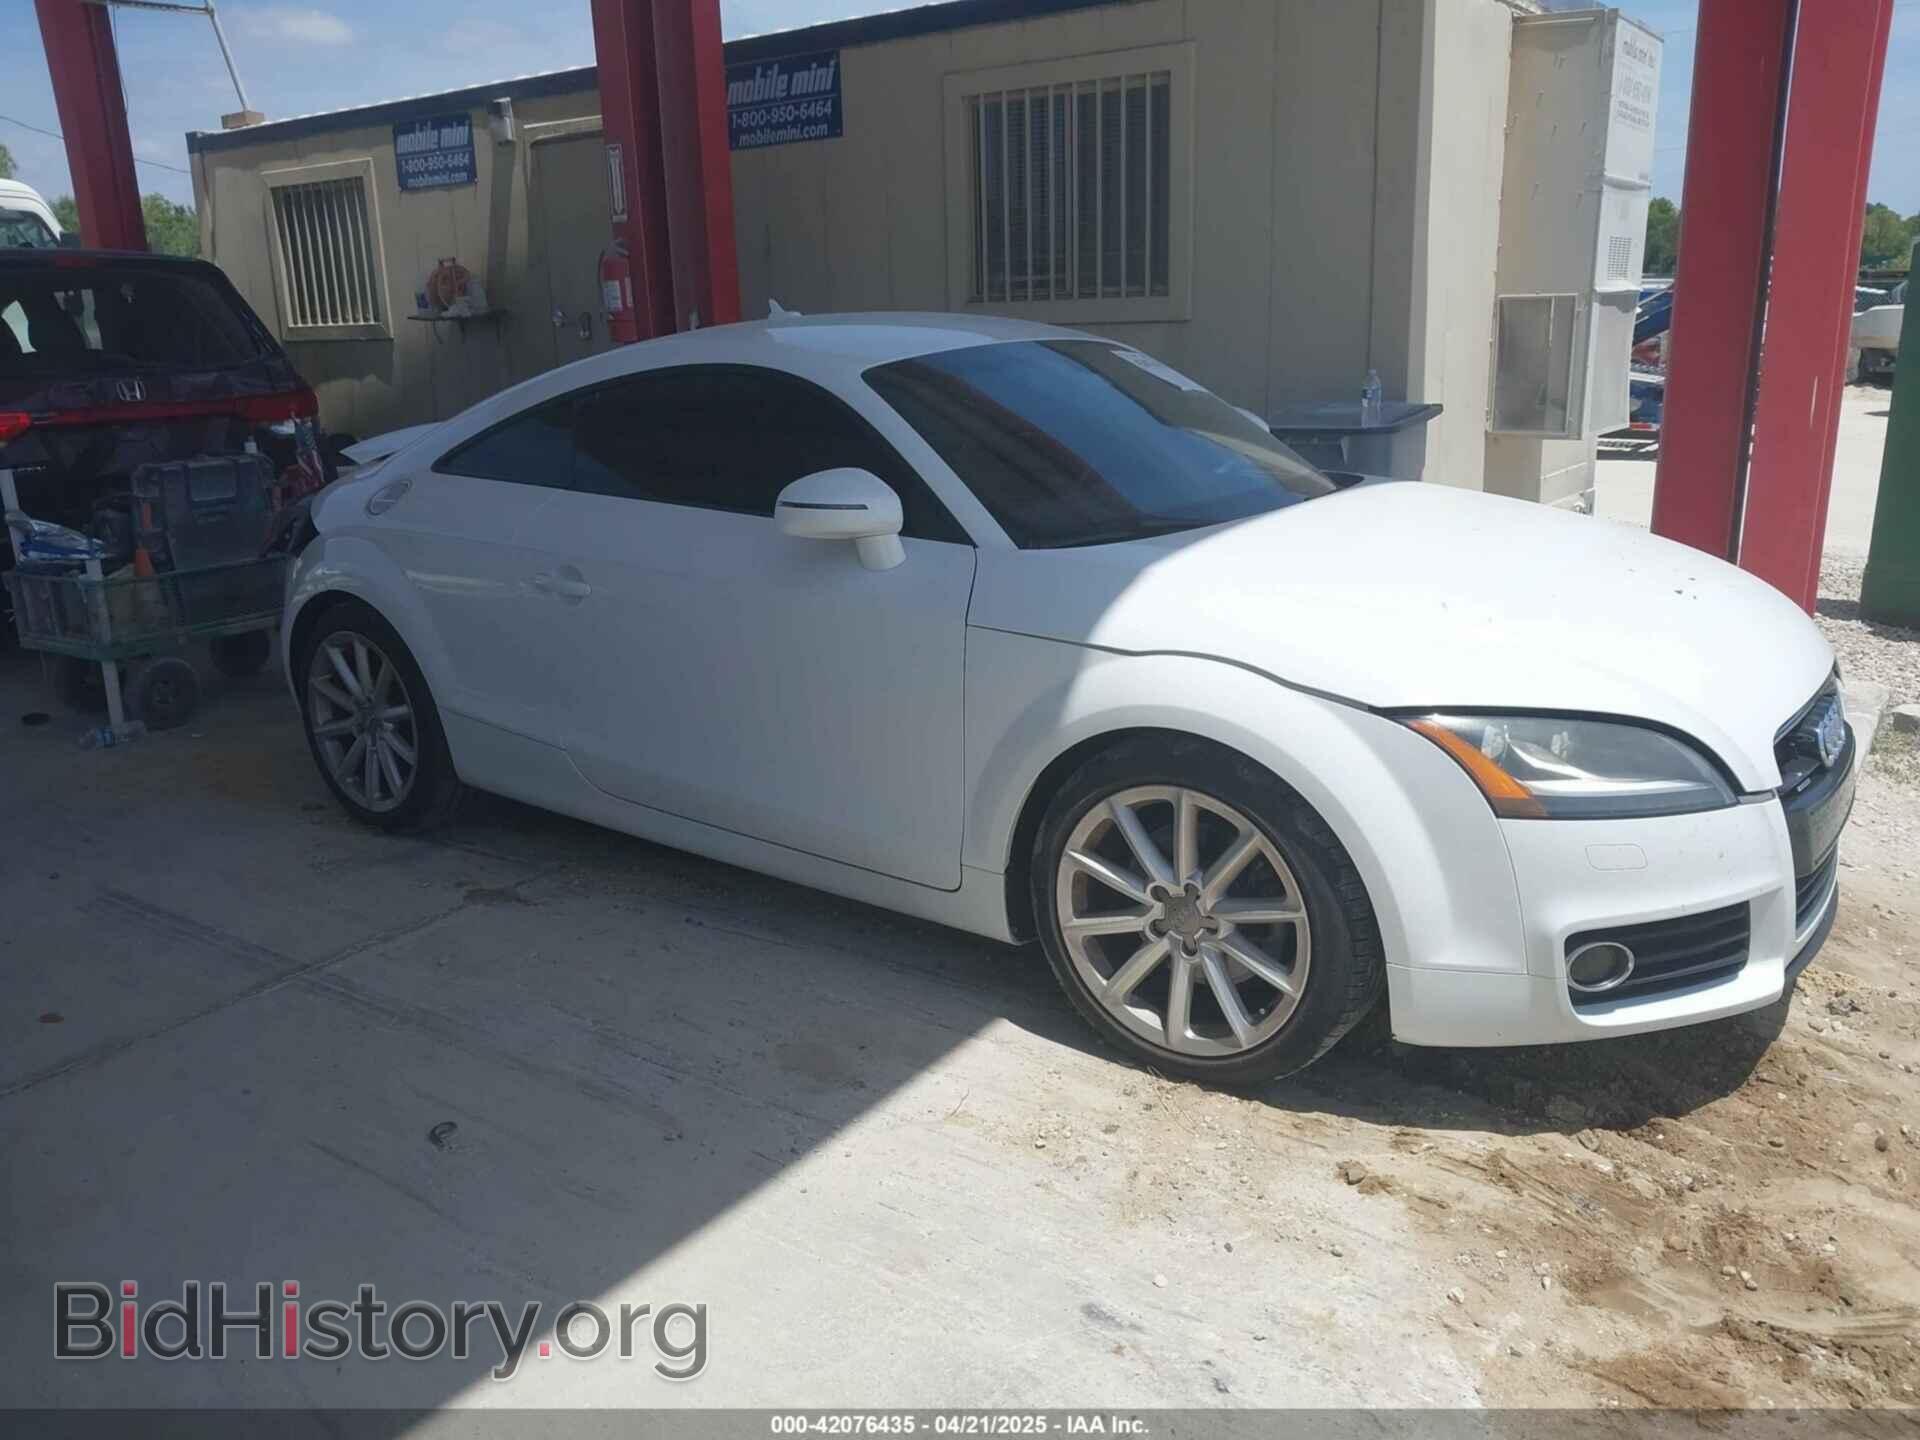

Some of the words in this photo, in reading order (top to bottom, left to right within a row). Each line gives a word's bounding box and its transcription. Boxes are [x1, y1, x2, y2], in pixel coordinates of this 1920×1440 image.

[727, 63, 789, 105] mobile
[790, 62, 835, 96] mini
[732, 99, 832, 129] 1-800-950-6464
[397, 121, 439, 154] mobile
[440, 120, 469, 149] mini
